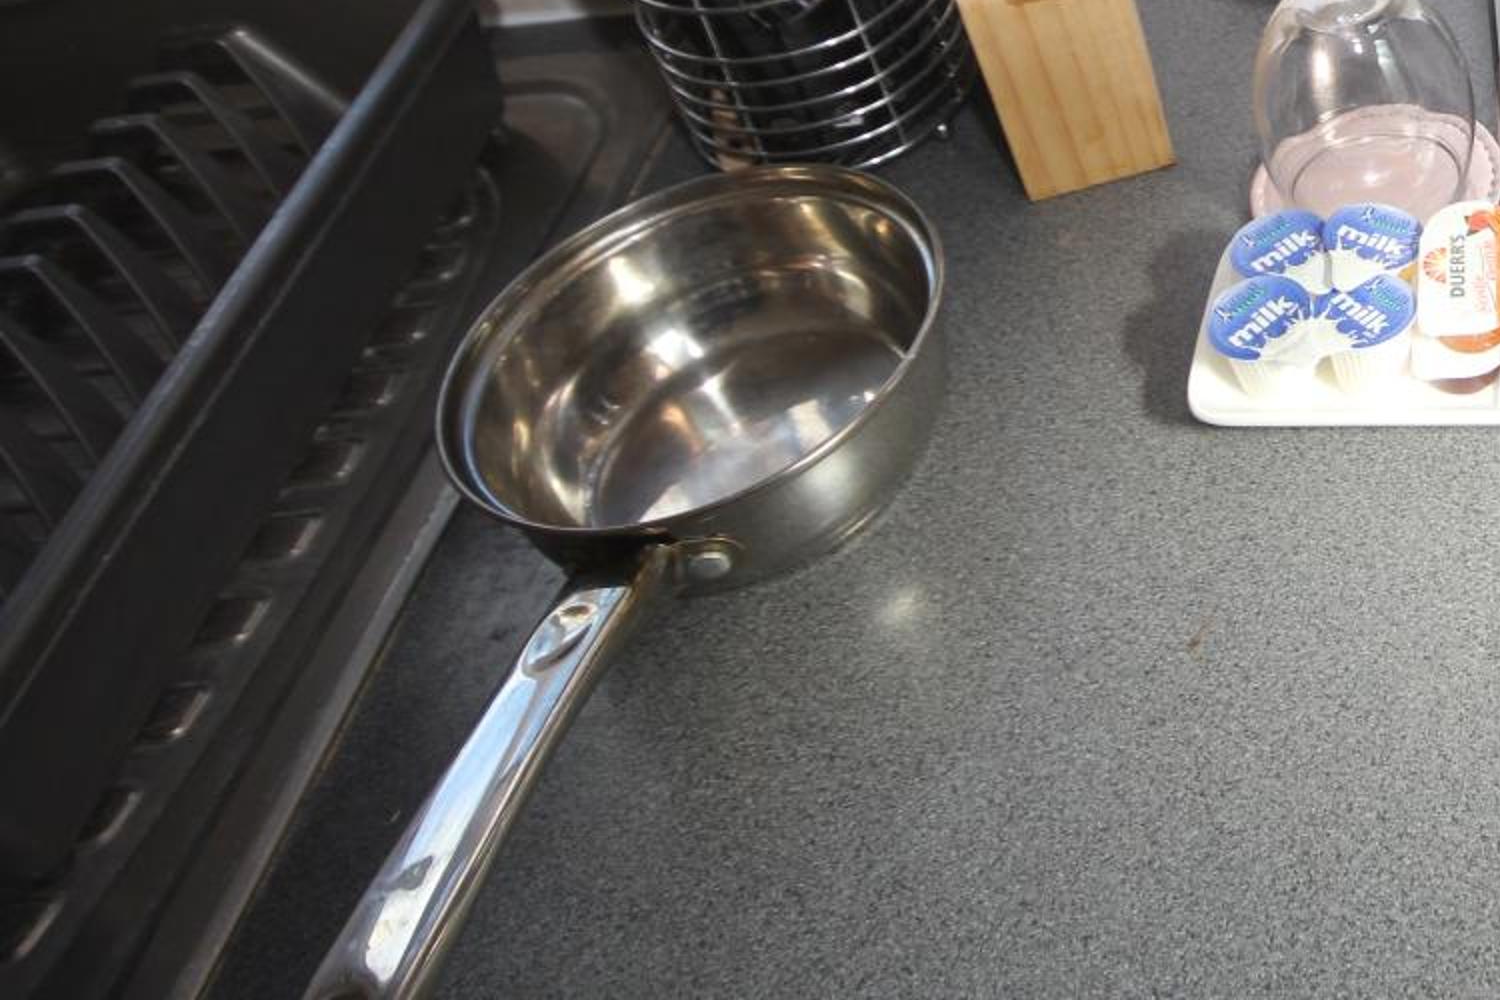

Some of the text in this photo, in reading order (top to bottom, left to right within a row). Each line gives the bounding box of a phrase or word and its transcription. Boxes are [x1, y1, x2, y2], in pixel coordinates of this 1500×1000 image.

[1251, 229, 1317, 272] milk
[1337, 224, 1406, 256] milk
[1228, 295, 1295, 348] milk
[1330, 292, 1390, 336] milk
